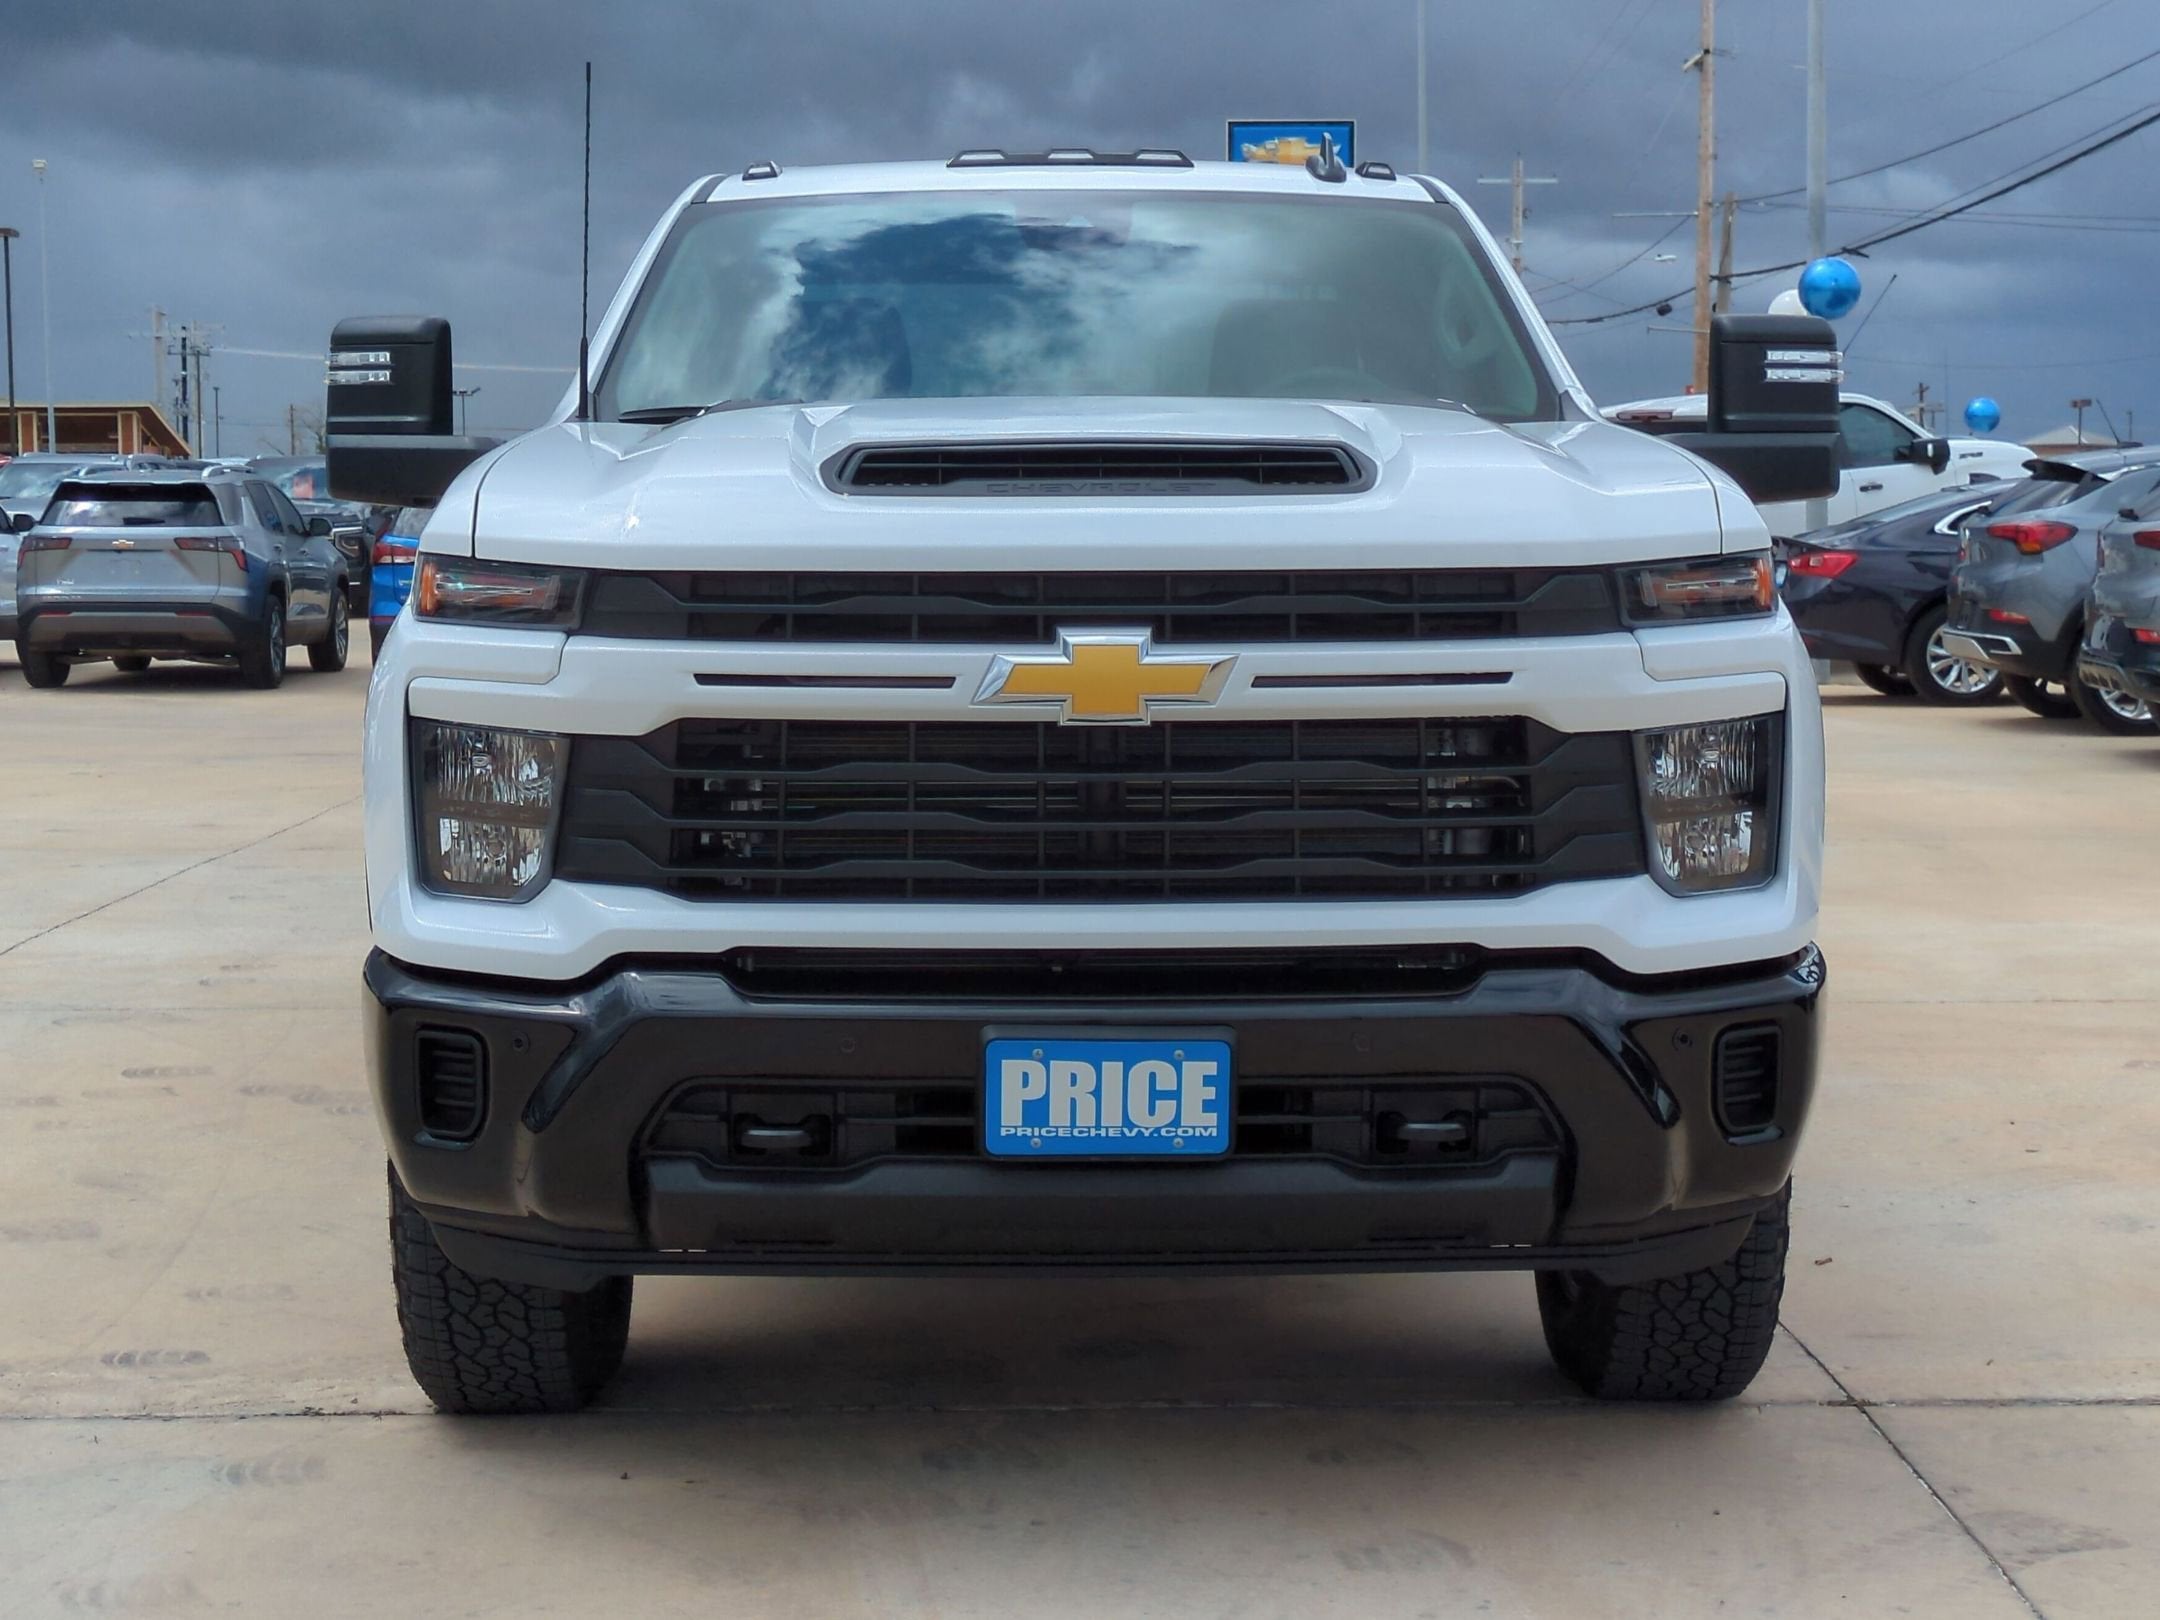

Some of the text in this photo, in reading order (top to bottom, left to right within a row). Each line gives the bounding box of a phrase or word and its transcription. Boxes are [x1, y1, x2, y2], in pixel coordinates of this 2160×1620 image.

[986, 482, 1217, 494] CHEVROLET
[1000, 1059, 1218, 1128] PRICE
[1000, 1126, 1218, 1138] PRICECHEVY.COM
